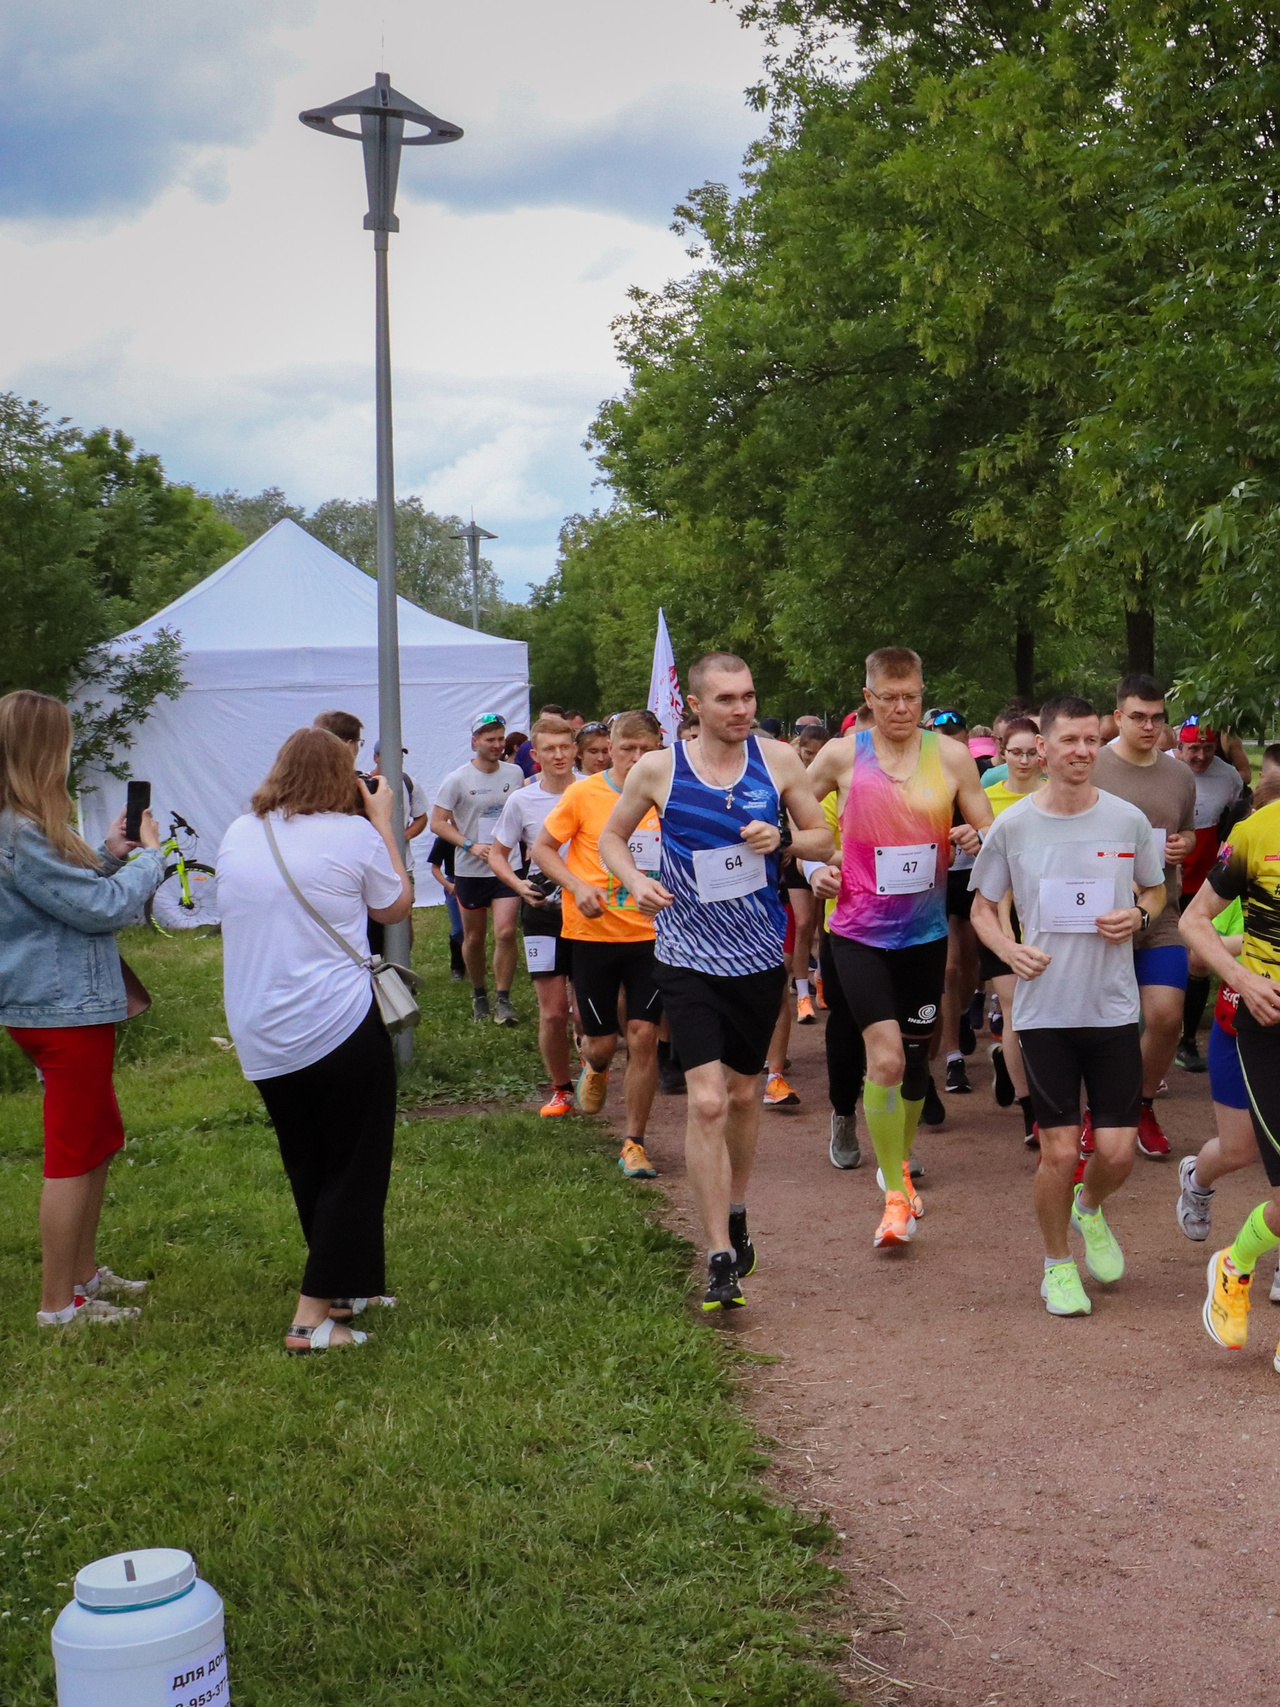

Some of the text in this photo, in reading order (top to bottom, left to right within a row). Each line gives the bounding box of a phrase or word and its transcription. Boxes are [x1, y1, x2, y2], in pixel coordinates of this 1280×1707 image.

[629, 842, 643, 853] 65
[725, 855, 743, 871] 64
[902, 861, 918, 873] 47
[1076, 892, 1085, 906] 8
[528, 948, 538, 957] 63
